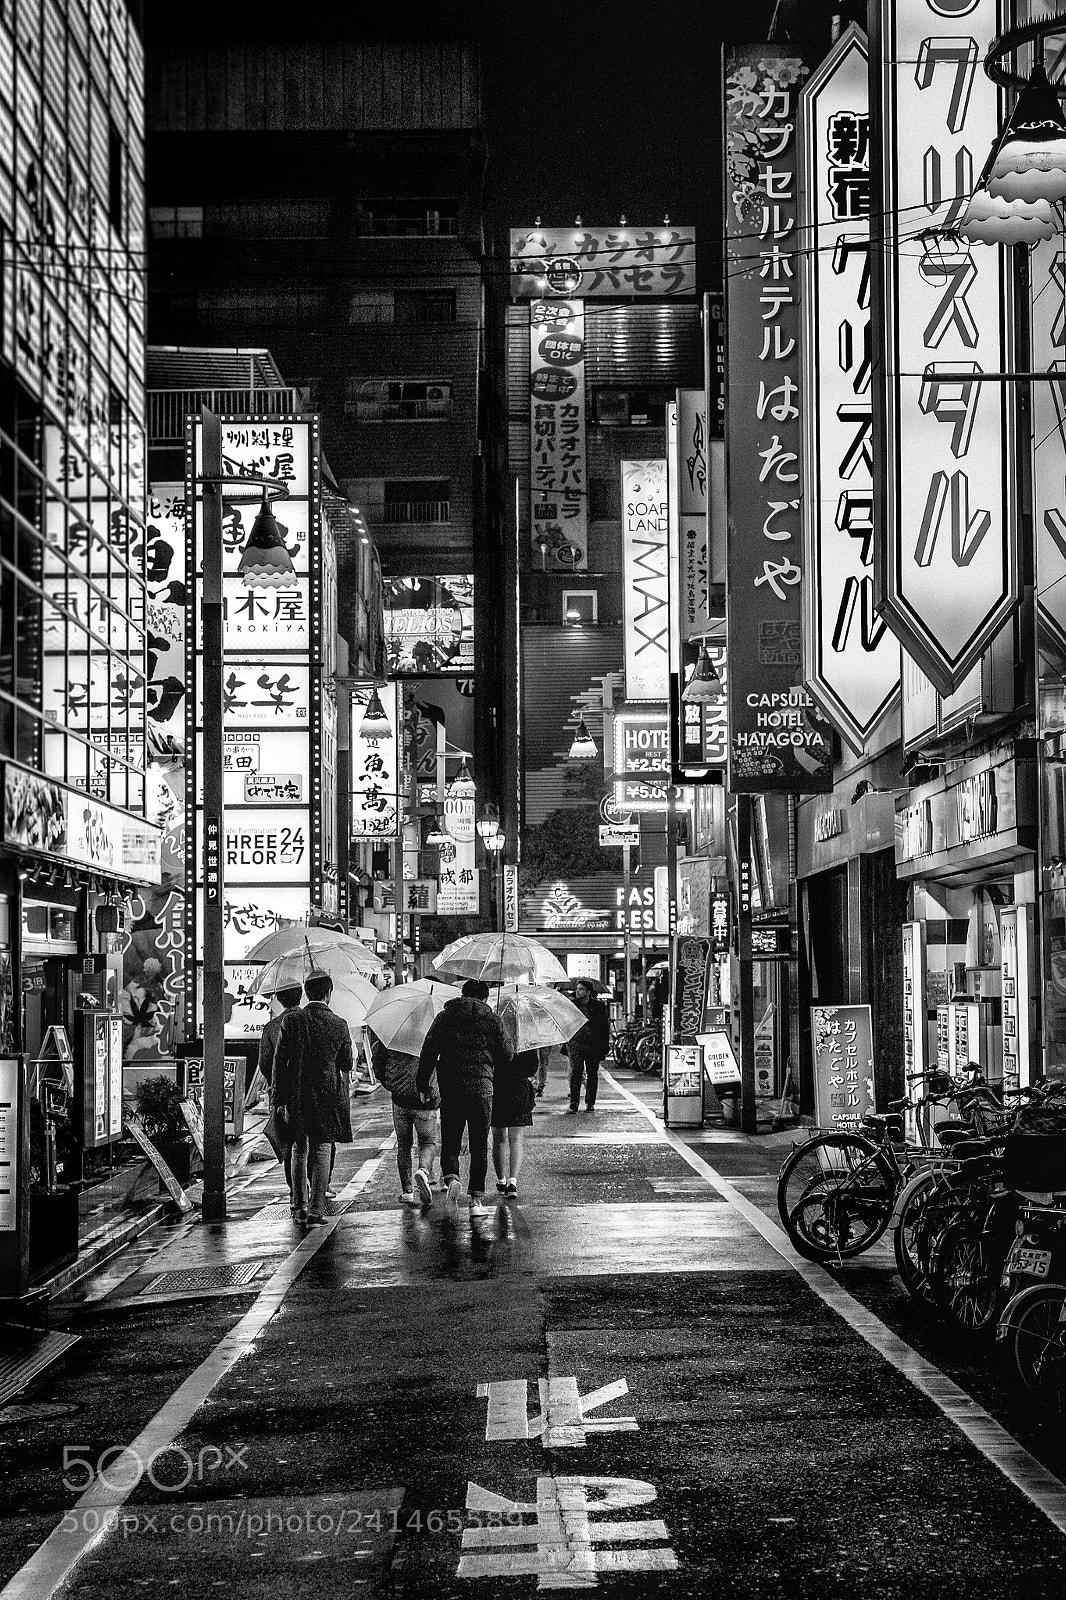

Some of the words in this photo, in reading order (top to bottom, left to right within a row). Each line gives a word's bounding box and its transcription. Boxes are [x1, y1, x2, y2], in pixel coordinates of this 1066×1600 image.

[574, 231, 694, 263] カラオケ
[588, 264, 686, 293] パセラ
[222, 426, 294, 449] 州料理
[560, 403, 582, 519] カラオケパセラ
[628, 517, 667, 532] LAND
[201, 590, 306, 621] 木屋
[402, 608, 425, 616] HYPER
[428, 608, 454, 616] STUDIO
[746, 693, 814, 707] CAPSULE
[757, 712, 804, 727] HOTEL
[625, 729, 668, 749] HOTE
[737, 732, 825, 746] HATAGOYA
[358, 752, 390, 813] 魚萬
[226, 834, 278, 849] HREE
[207, 824, 218, 899] 仲見世通り
[227, 850, 277, 865] RLOR
[440, 867, 474, 886] 成都
[506, 869, 515, 928] カラオケパセラ
[616, 887, 655, 906] FAS
[712, 900, 728, 942] 営業中
[707, 1052, 730, 1061] GOLDEN
[826, 1019, 845, 1089] はたごや
[844, 1019, 860, 1107] カプセルホテル
[831, 1113, 861, 1121] CAPSULE
[836, 1120, 858, 1129] HOTEL
